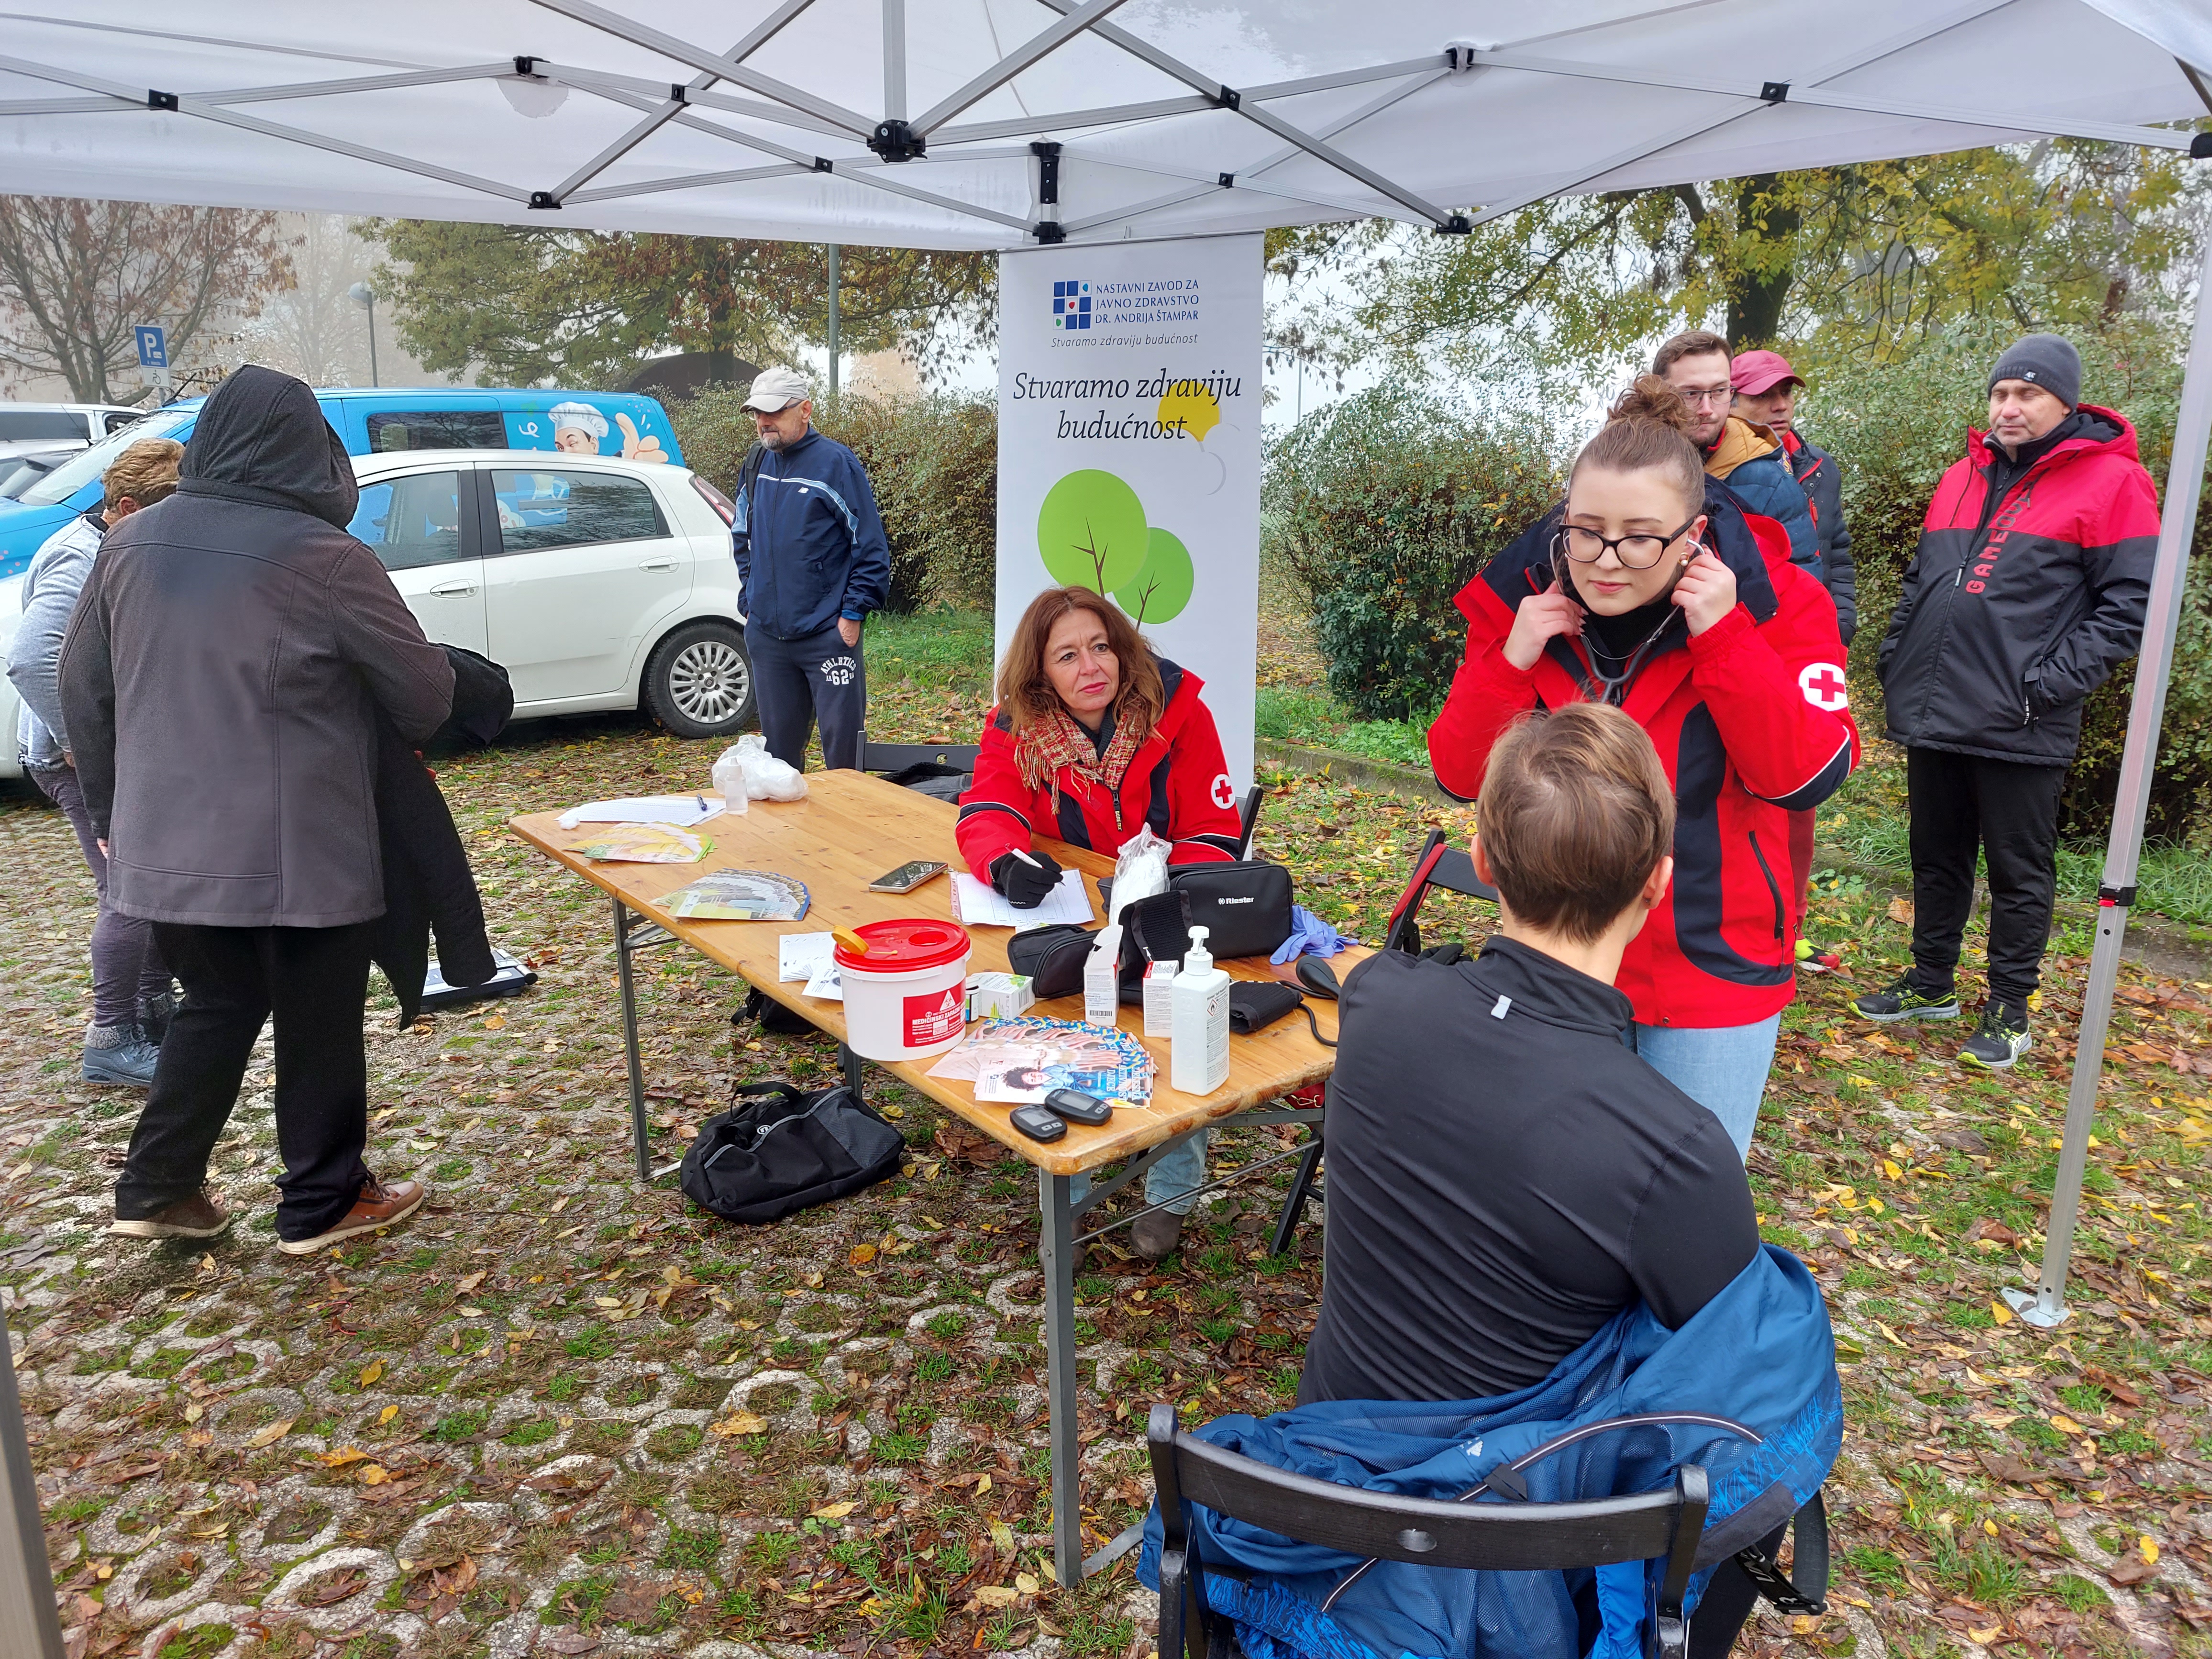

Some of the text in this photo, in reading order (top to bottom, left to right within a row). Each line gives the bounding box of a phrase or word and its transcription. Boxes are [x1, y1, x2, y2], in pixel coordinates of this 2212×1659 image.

[1096, 279, 1199, 294] NASTAVNI ZAVOD ZA
[1096, 295, 1199, 310] JAVNO ZDRAVSTVO
[1095, 309, 1199, 324] DR. ANDRIJA ŠTAMPAR
[144, 332, 157, 358] P
[1051, 333, 1198, 347] Stvaramo zdraviju budućnost
[1013, 368, 1241, 406] Stvaramo zdraviju
[1057, 410, 1188, 439] budućnost
[820, 656, 856, 675] ATHLETICS
[831, 669, 849, 685] 62
[1106, 1069, 1116, 1092] DJECE
[1118, 1064, 1127, 1102] AKTIVNOST
